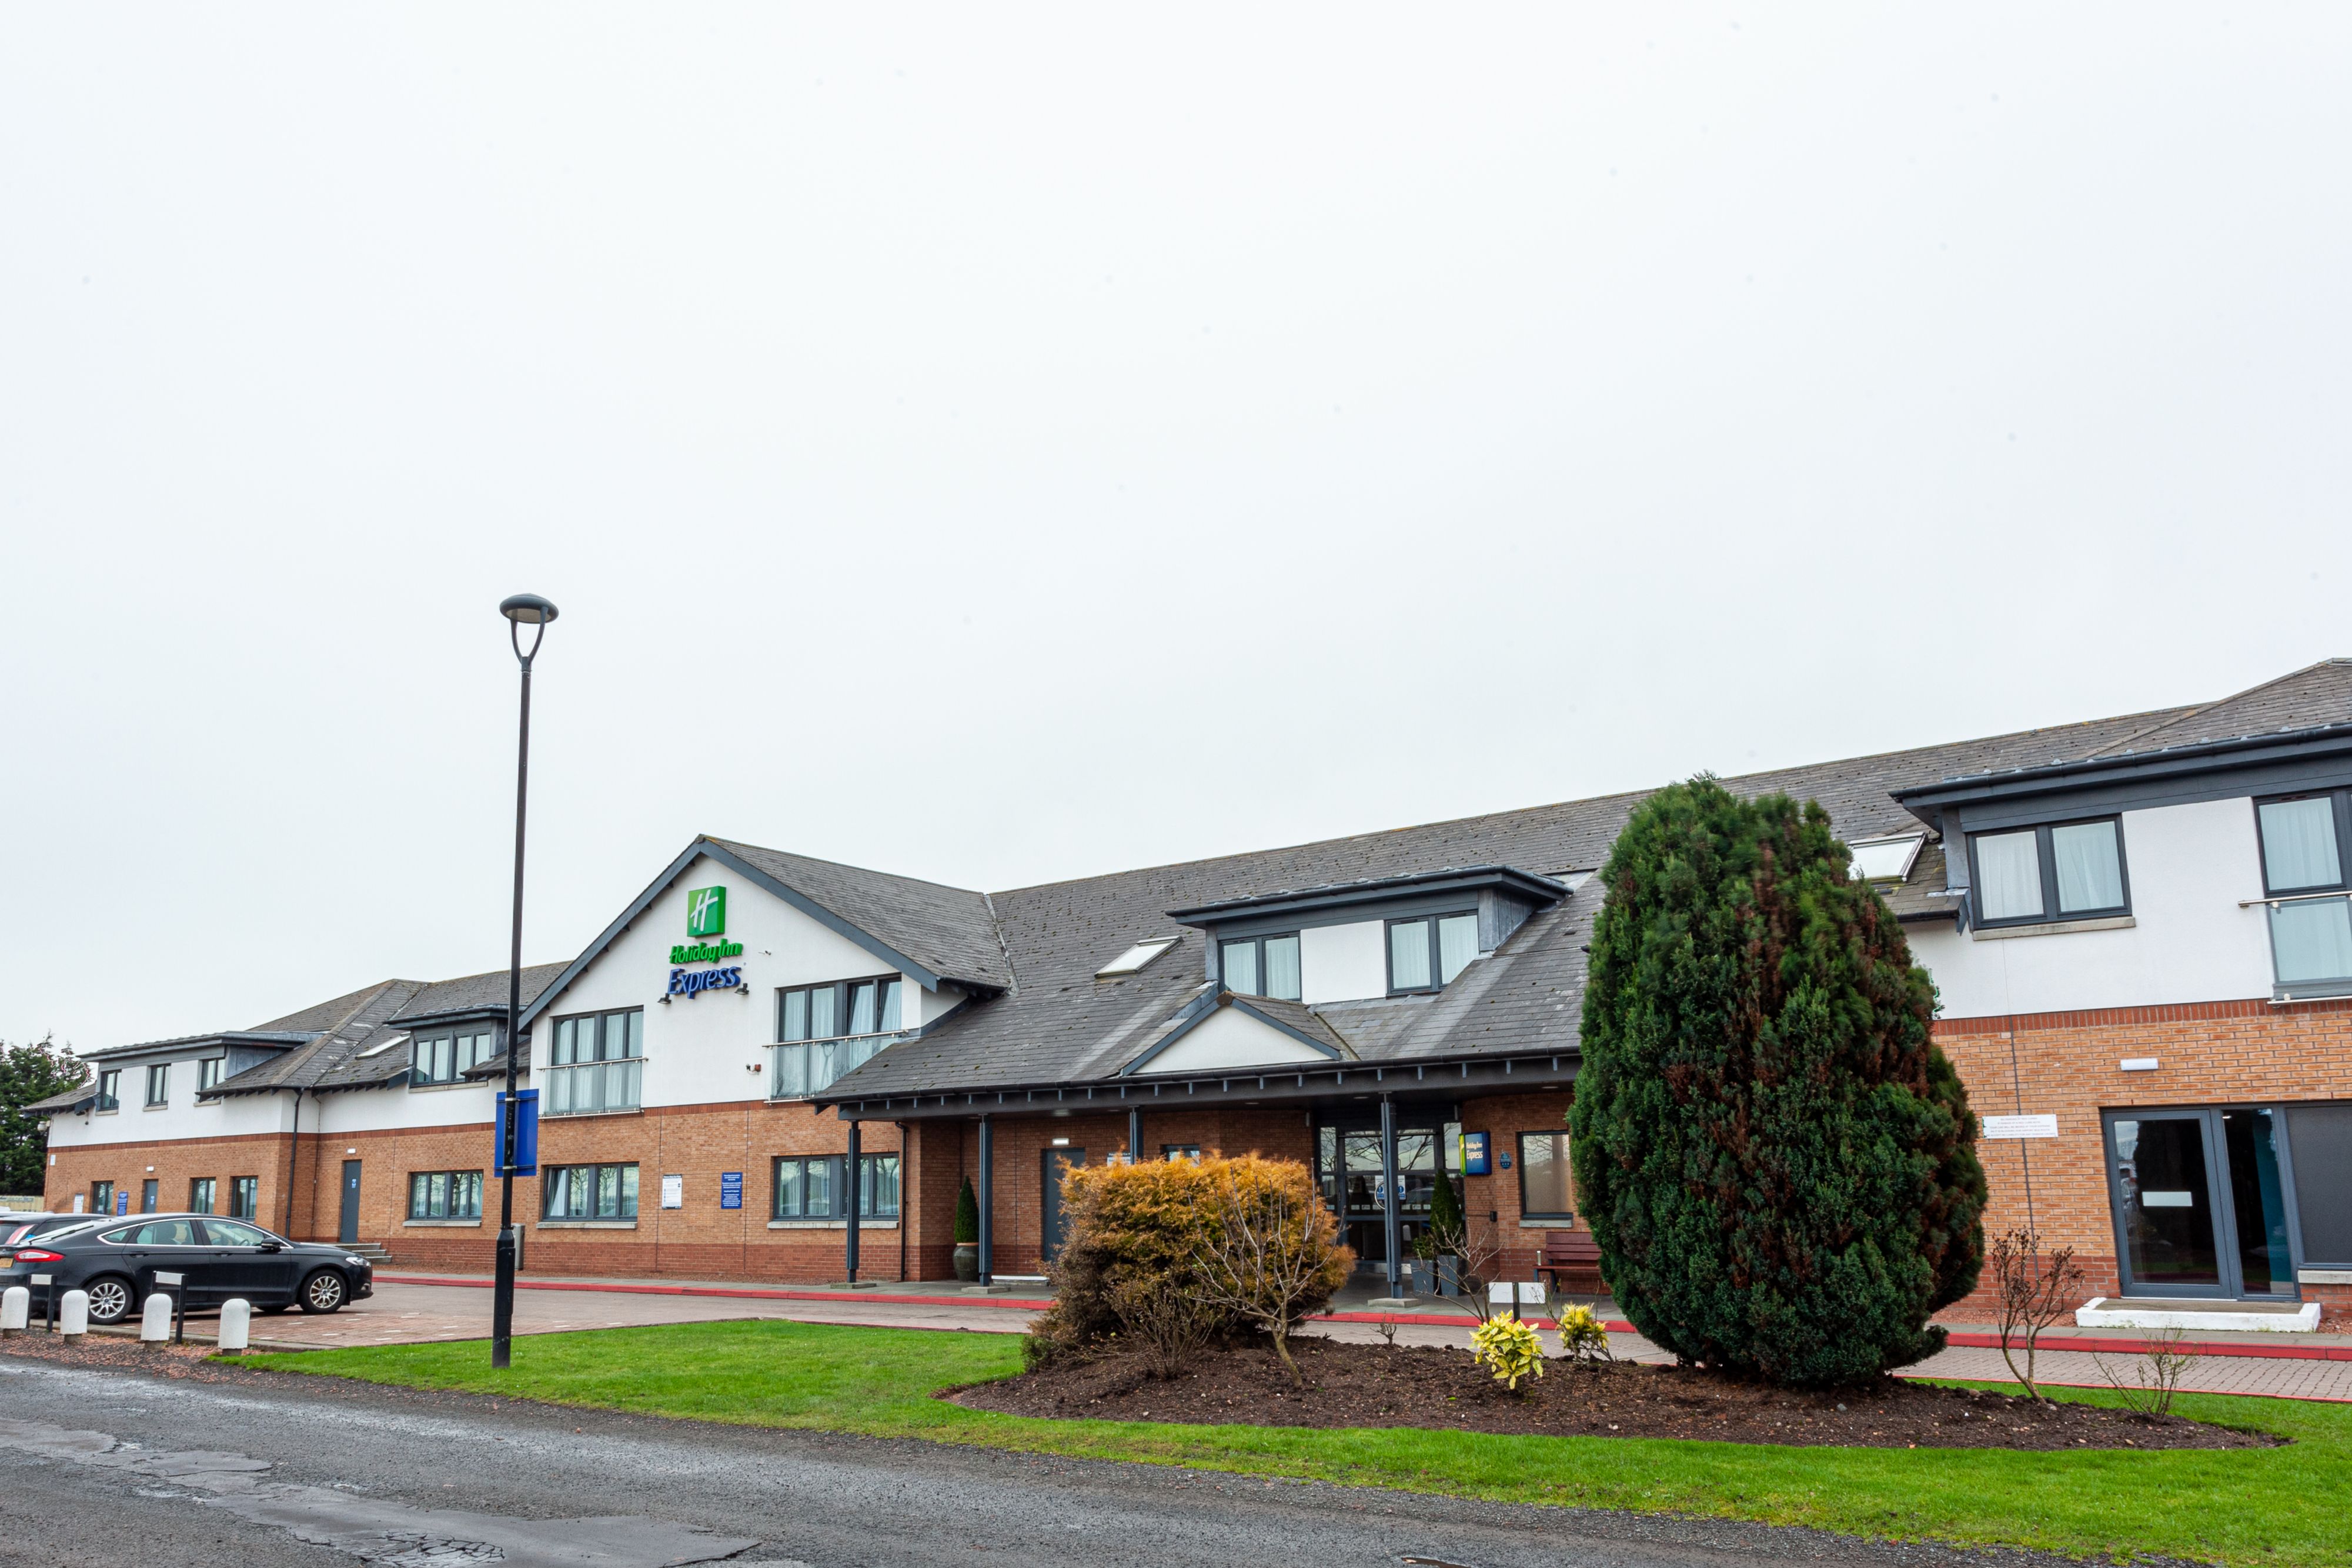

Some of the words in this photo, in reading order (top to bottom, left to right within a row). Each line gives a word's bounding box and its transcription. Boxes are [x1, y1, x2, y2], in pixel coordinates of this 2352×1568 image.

[669, 942, 719, 964] Holiday
[719, 938, 743, 957] Inn
[667, 966, 742, 999] Express
[1467, 1150, 1483, 1161] Express
